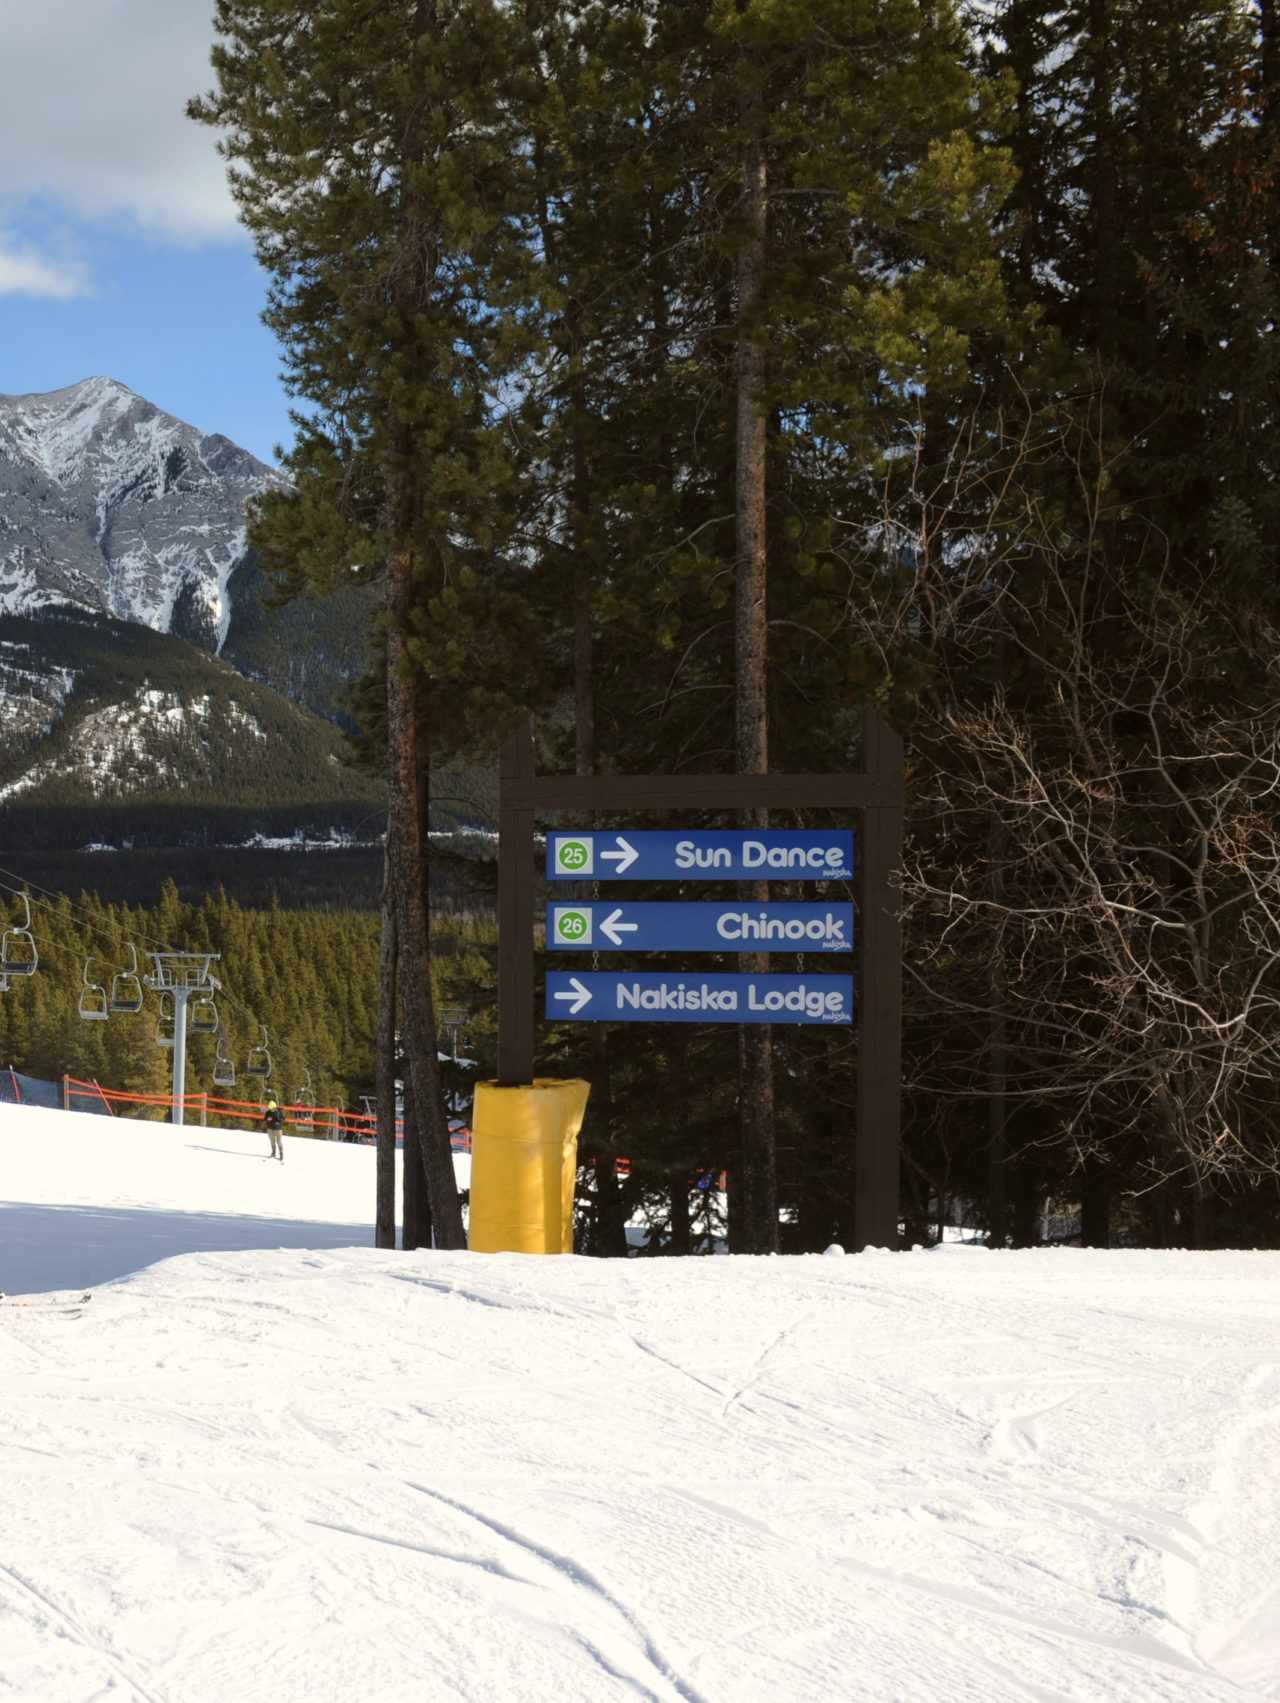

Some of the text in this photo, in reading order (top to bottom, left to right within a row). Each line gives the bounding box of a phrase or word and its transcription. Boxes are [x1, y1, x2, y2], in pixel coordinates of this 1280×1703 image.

[563, 848, 584, 864] 25
[675, 840, 844, 868] Sun Dance
[562, 918, 583, 934] 26
[716, 912, 844, 940] Chinook
[616, 982, 844, 1017] Nakiska Lodge
